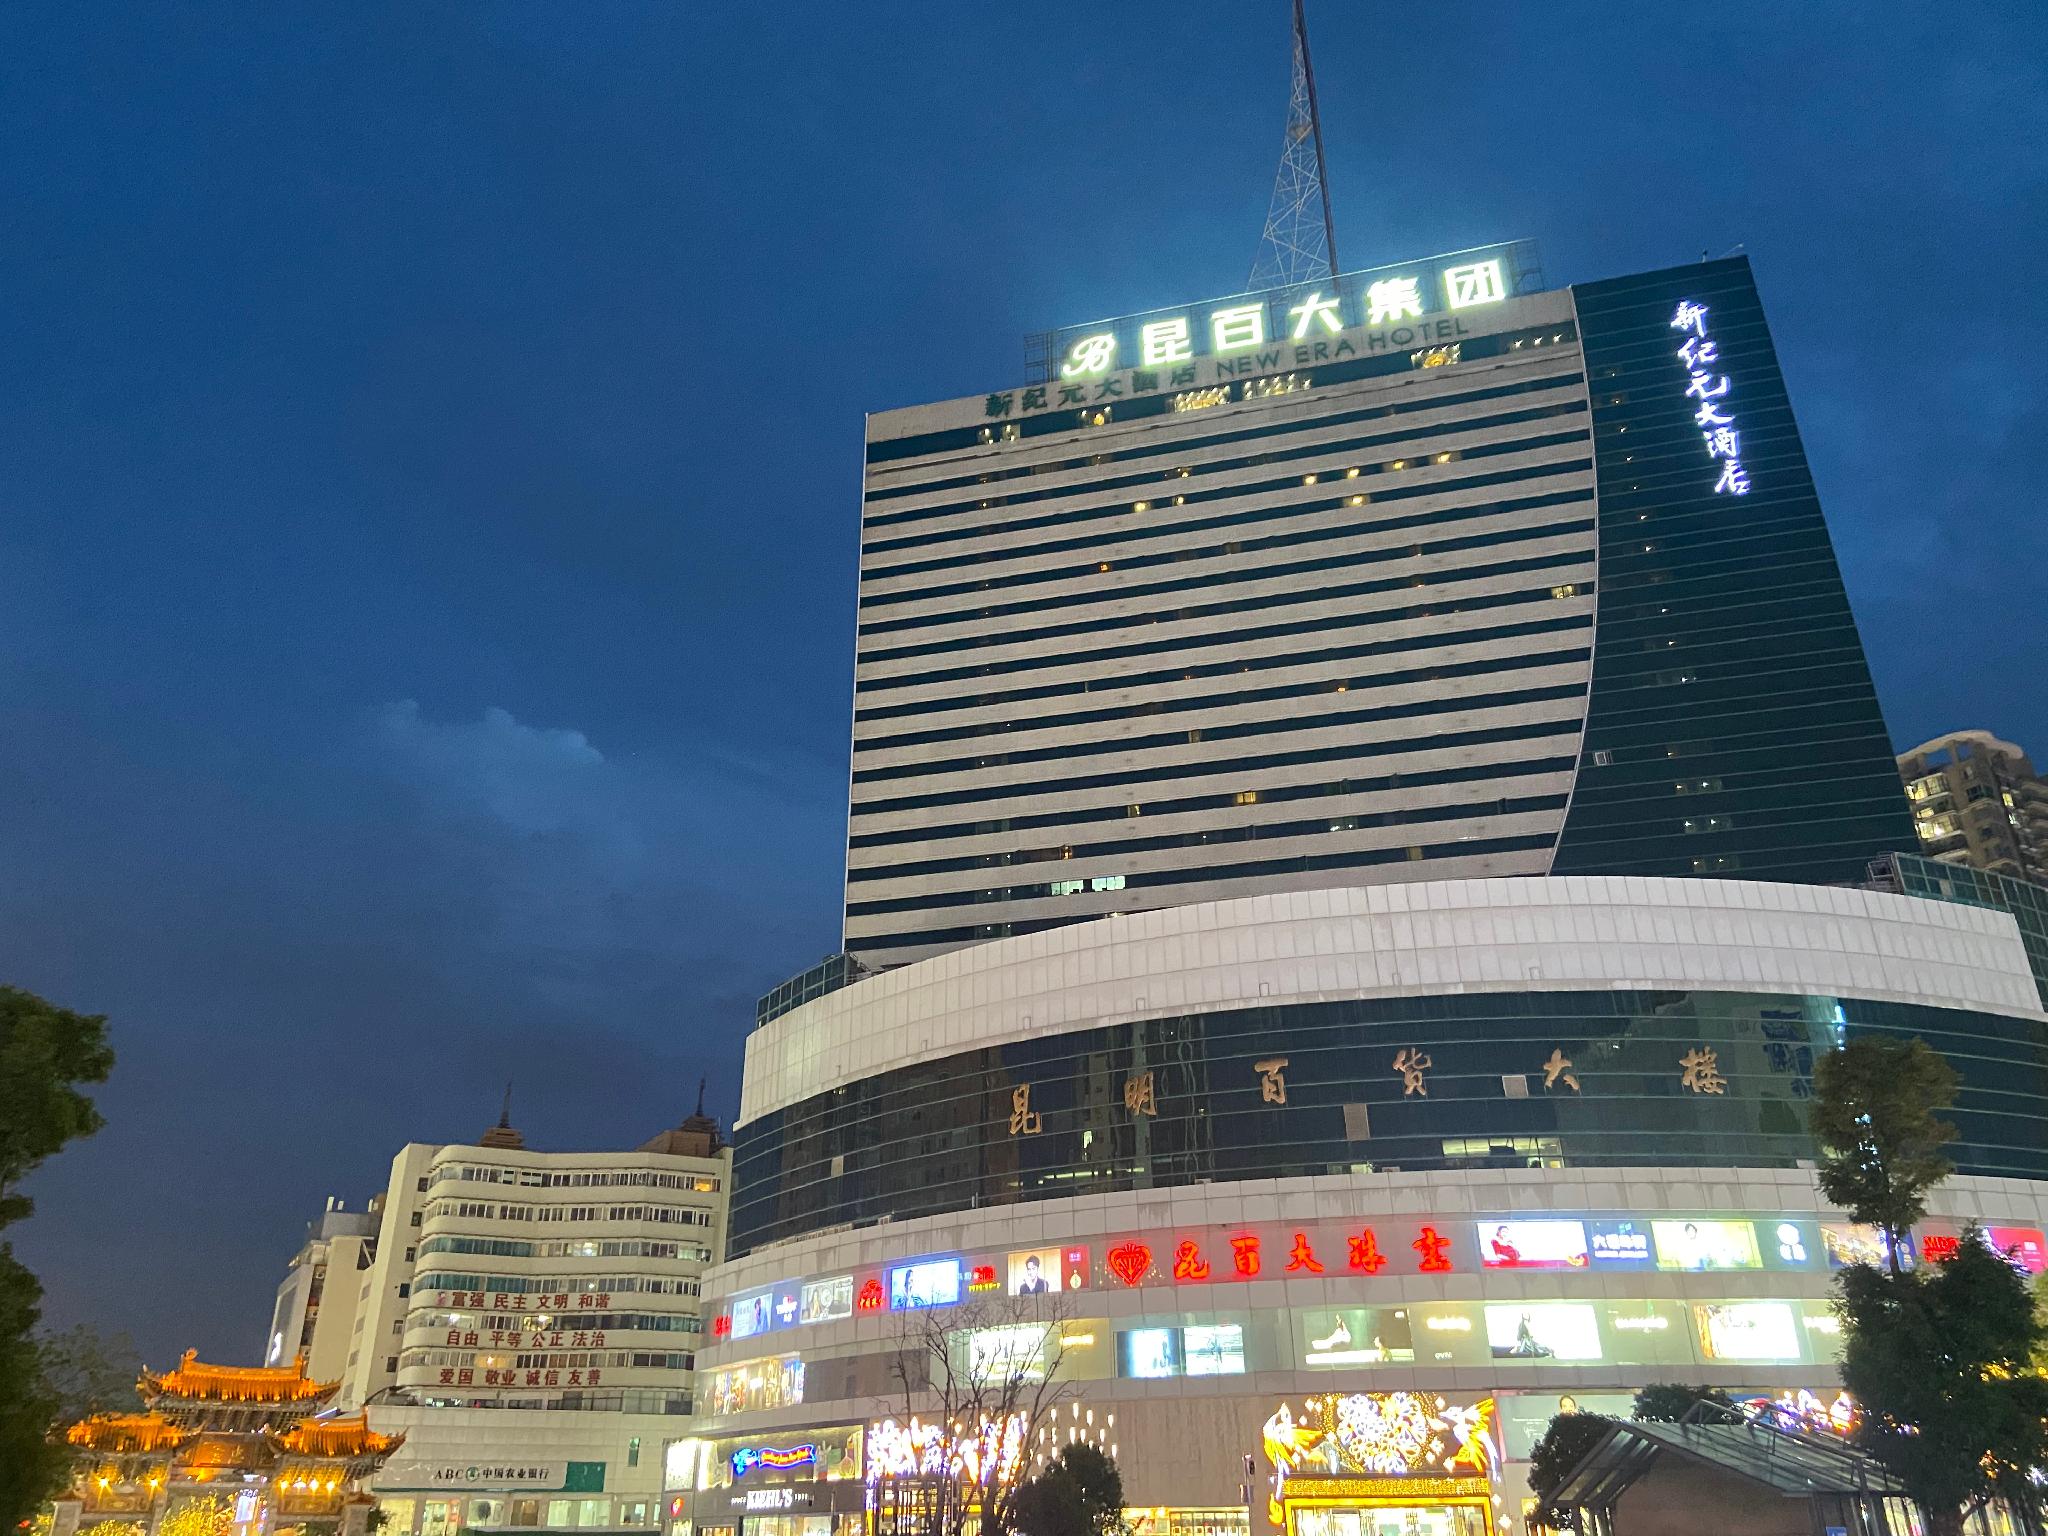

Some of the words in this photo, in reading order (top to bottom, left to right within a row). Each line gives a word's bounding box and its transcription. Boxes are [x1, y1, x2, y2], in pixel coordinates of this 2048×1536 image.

[1141, 258, 1508, 367] 昆百大集团
[1217, 349, 1280, 378] NEW
[1295, 340, 1356, 364] ERA
[1368, 318, 1469, 350] HOTEL
[1671, 300, 1751, 495] 新纪元大酒店
[1009, 1048, 1727, 1136] 昆明百货大楼
[452, 1291, 484, 1308] 富强
[493, 1293, 527, 1310] 民主
[536, 1293, 568, 1309] 文明
[578, 1293, 611, 1309] 和谐
[446, 1331, 479, 1347] 自由
[489, 1331, 522, 1348] 平等
[531, 1332, 564, 1349] 公正
[571, 1332, 606, 1348] 法治
[439, 1368, 474, 1385] 爱国
[485, 1369, 516, 1386] 敬业
[526, 1369, 558, 1386] 诚信
[568, 1369, 601, 1386] 友善
[434, 1468, 464, 1480] ABC
[482, 1467, 549, 1480] 中国农业银行
[747, 1488, 793, 1510] KIEHL'S
